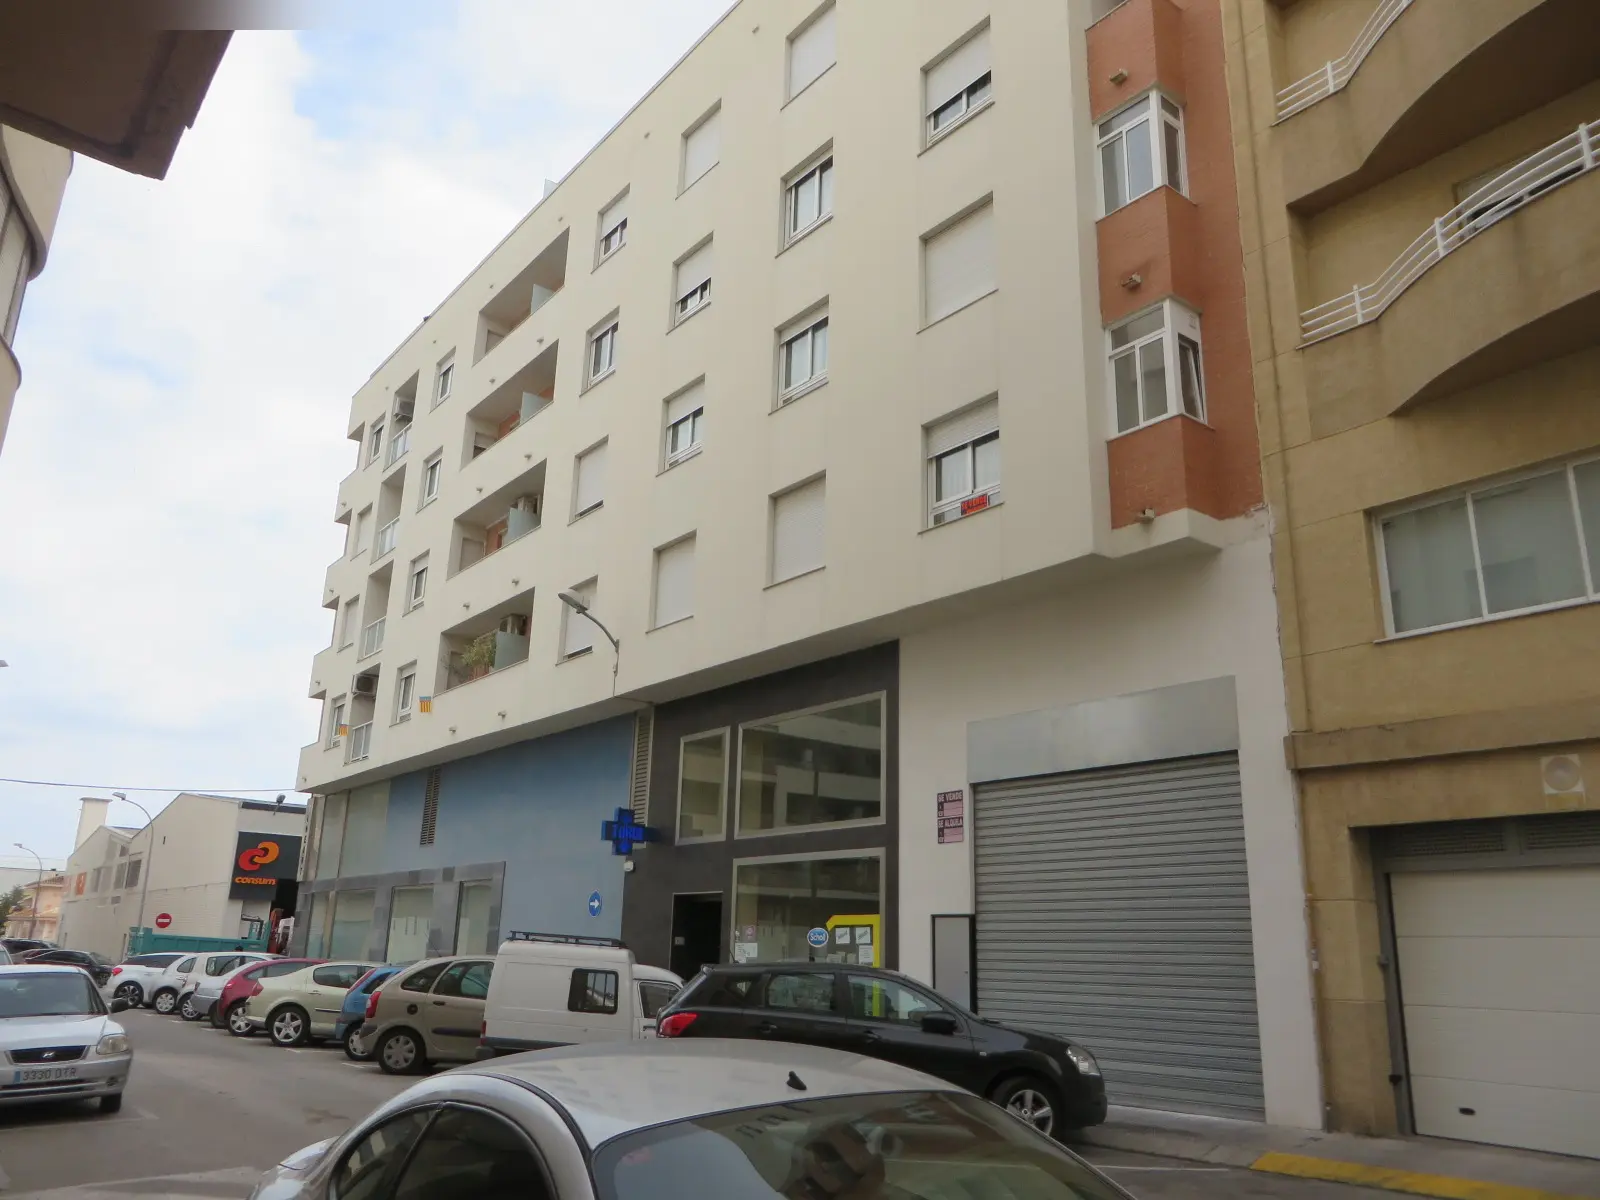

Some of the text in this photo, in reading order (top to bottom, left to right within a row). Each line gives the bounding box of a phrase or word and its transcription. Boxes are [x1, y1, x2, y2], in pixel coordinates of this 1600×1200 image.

[938, 792, 963, 802] SE VENDE
[945, 819, 963, 828] ALQUILA
[235, 876, 277, 885] consum
